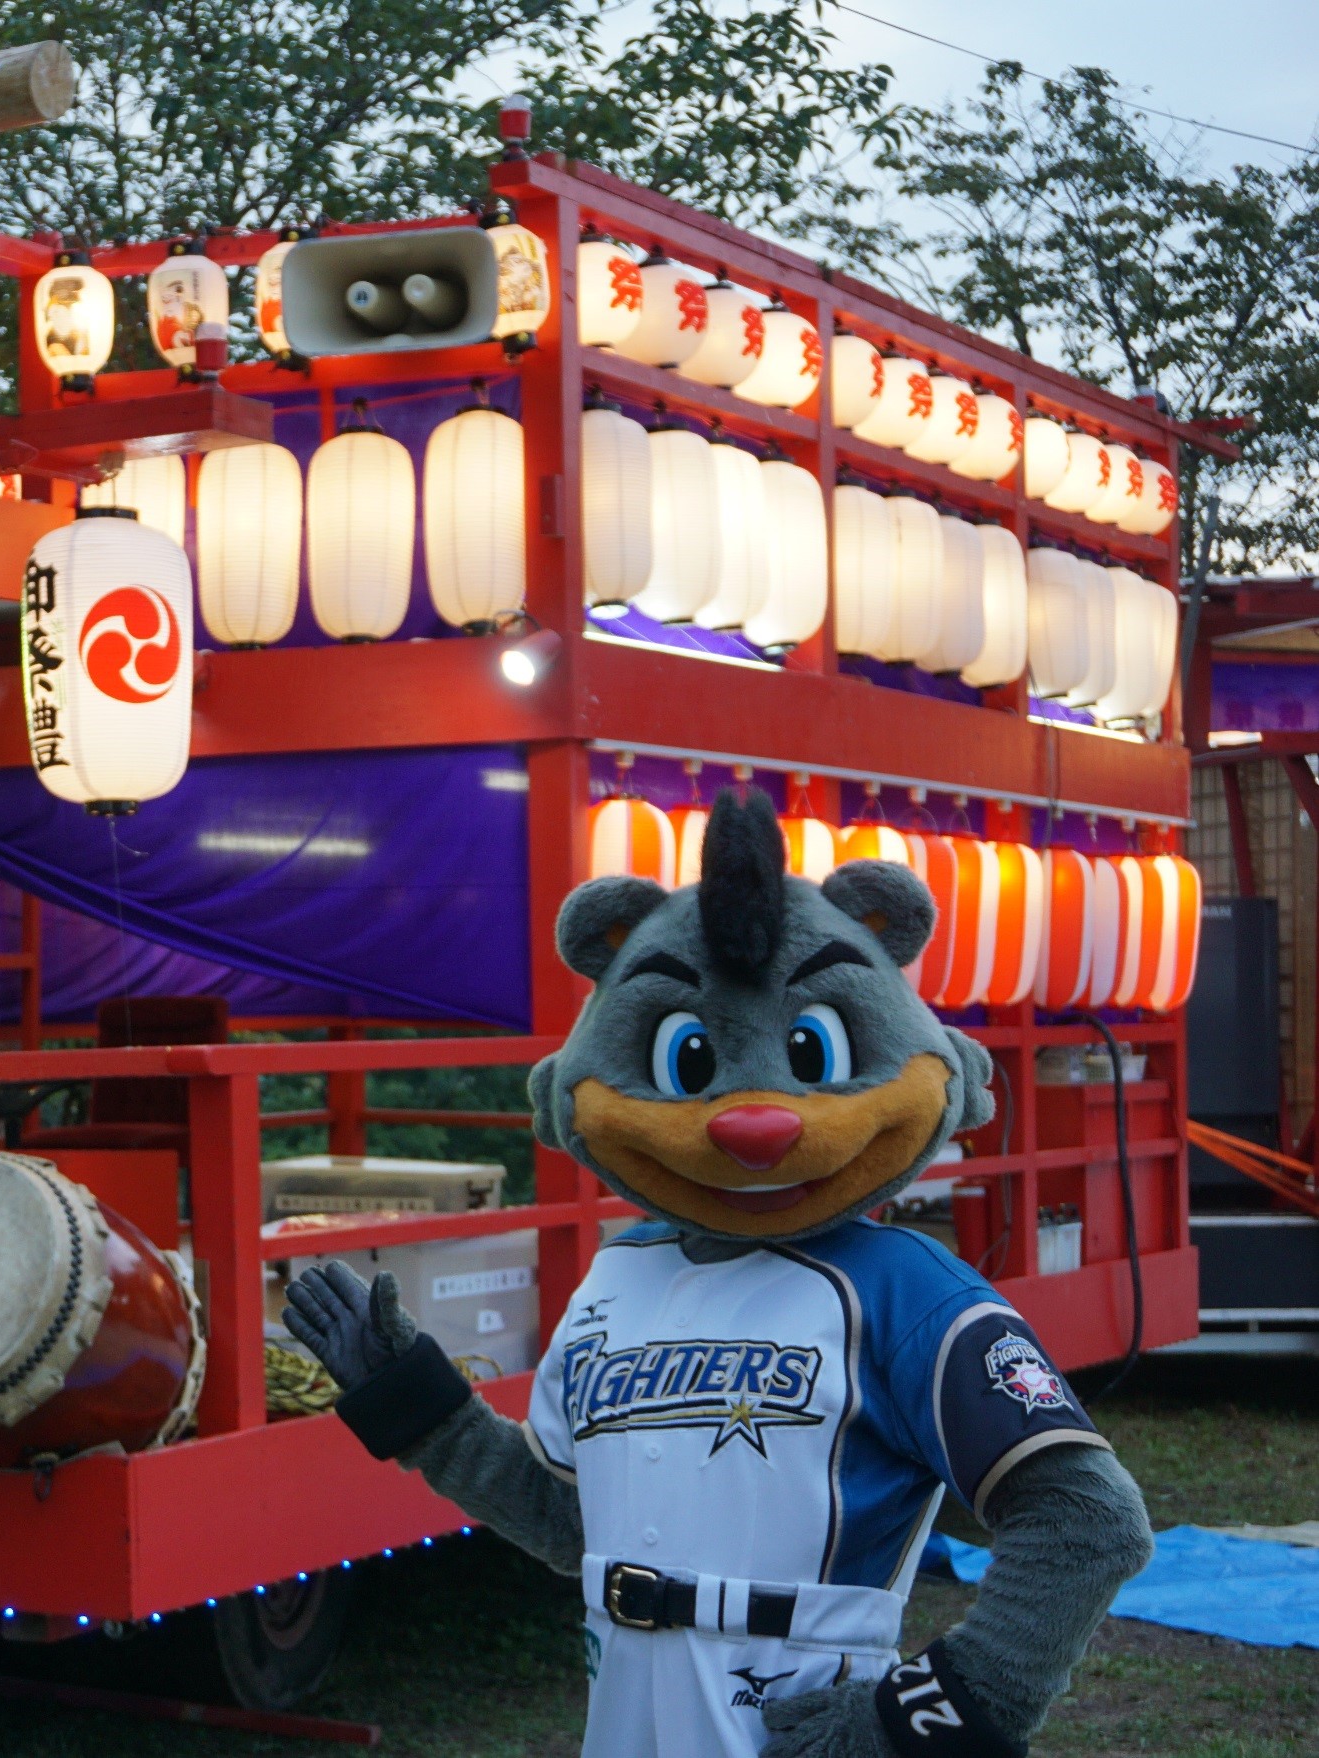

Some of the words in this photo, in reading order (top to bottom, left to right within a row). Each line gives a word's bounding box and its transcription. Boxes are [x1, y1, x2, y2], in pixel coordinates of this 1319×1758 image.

[607, 256, 643, 312] 祭
[674, 279, 707, 332] 祭
[563, 1331, 822, 1432] FIGHTERS
[890, 1652, 963, 1736] 212
